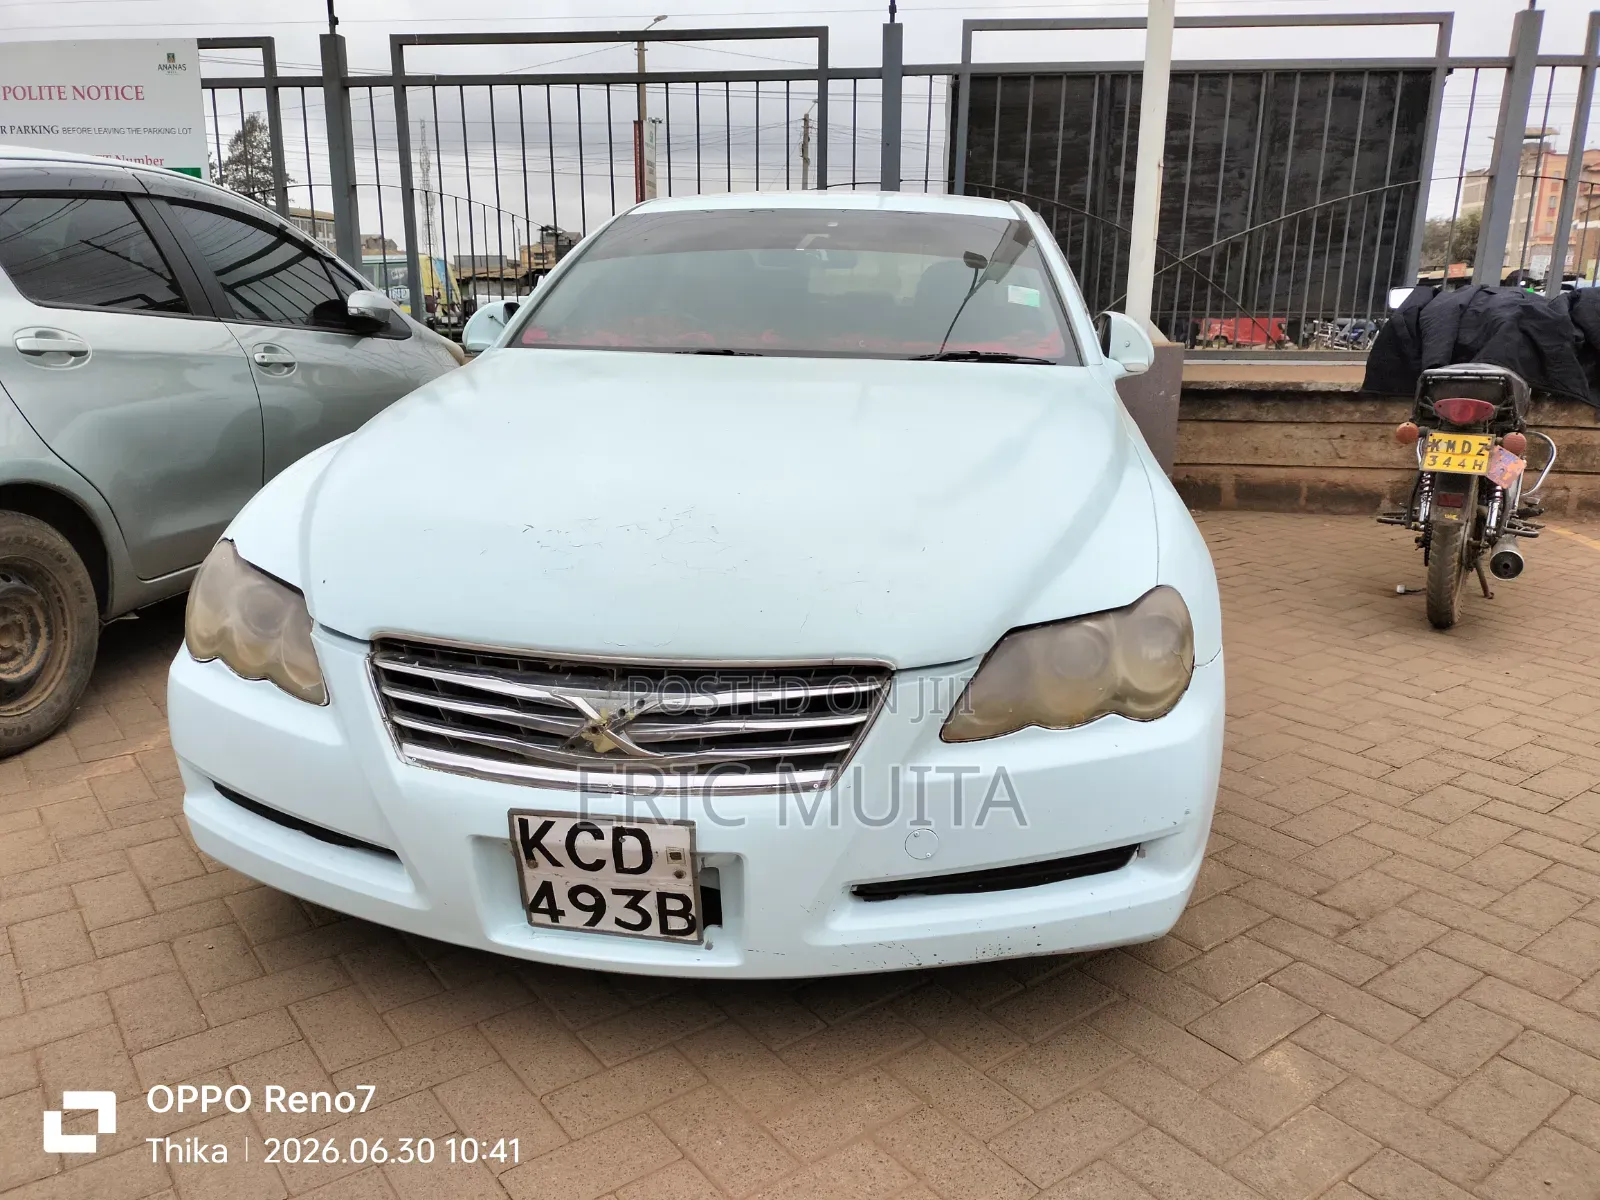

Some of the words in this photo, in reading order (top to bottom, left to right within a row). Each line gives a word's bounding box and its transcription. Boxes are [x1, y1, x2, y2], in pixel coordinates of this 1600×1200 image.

[157, 63, 187, 71] ANANAS
[1, 85, 68, 101] POLITE
[72, 85, 145, 101] NOTICE
[9, 125, 59, 135] PARKING
[62, 127, 92, 135] BEFORE
[94, 127, 126, 135] LEAVING
[127, 127, 142, 135] THE
[143, 127, 176, 135] PARKING
[177, 127, 192, 135] LOT
[1427, 456, 1484, 470] 344H
[518, 817, 653, 875] KCD
[529, 880, 697, 937] 493B
